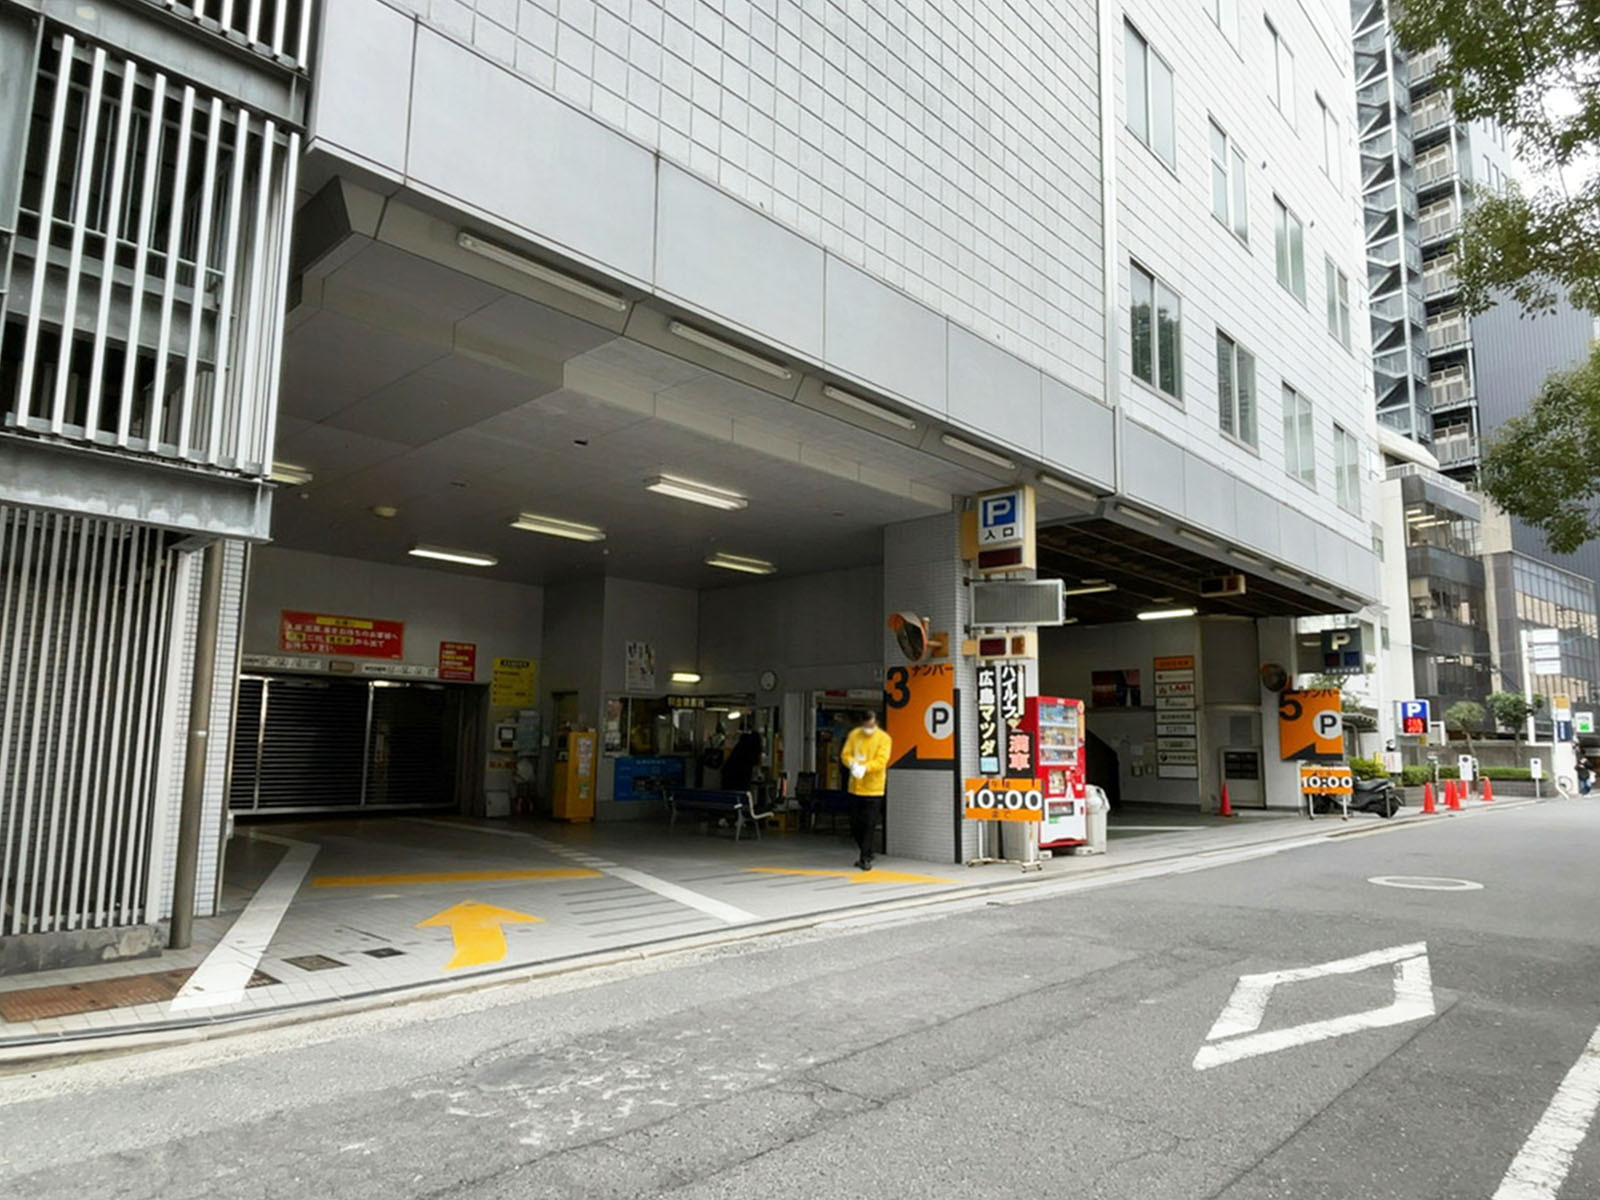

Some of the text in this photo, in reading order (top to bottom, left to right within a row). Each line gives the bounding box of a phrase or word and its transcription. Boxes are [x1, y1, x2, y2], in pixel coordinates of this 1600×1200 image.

[987, 498, 1012, 526] P
[985, 527, 1014, 540] 入口
[1331, 632, 1351, 650] P
[911, 664, 954, 677] ナンバー
[885, 666, 911, 709] 3
[978, 670, 997, 757] 広島マツダ
[1278, 690, 1303, 722] 5
[1407, 703, 1421, 717] P
[931, 707, 949, 734] P
[1319, 714, 1337, 735] P
[1302, 776, 1353, 788] 10:00
[965, 788, 1043, 811] 10:00
